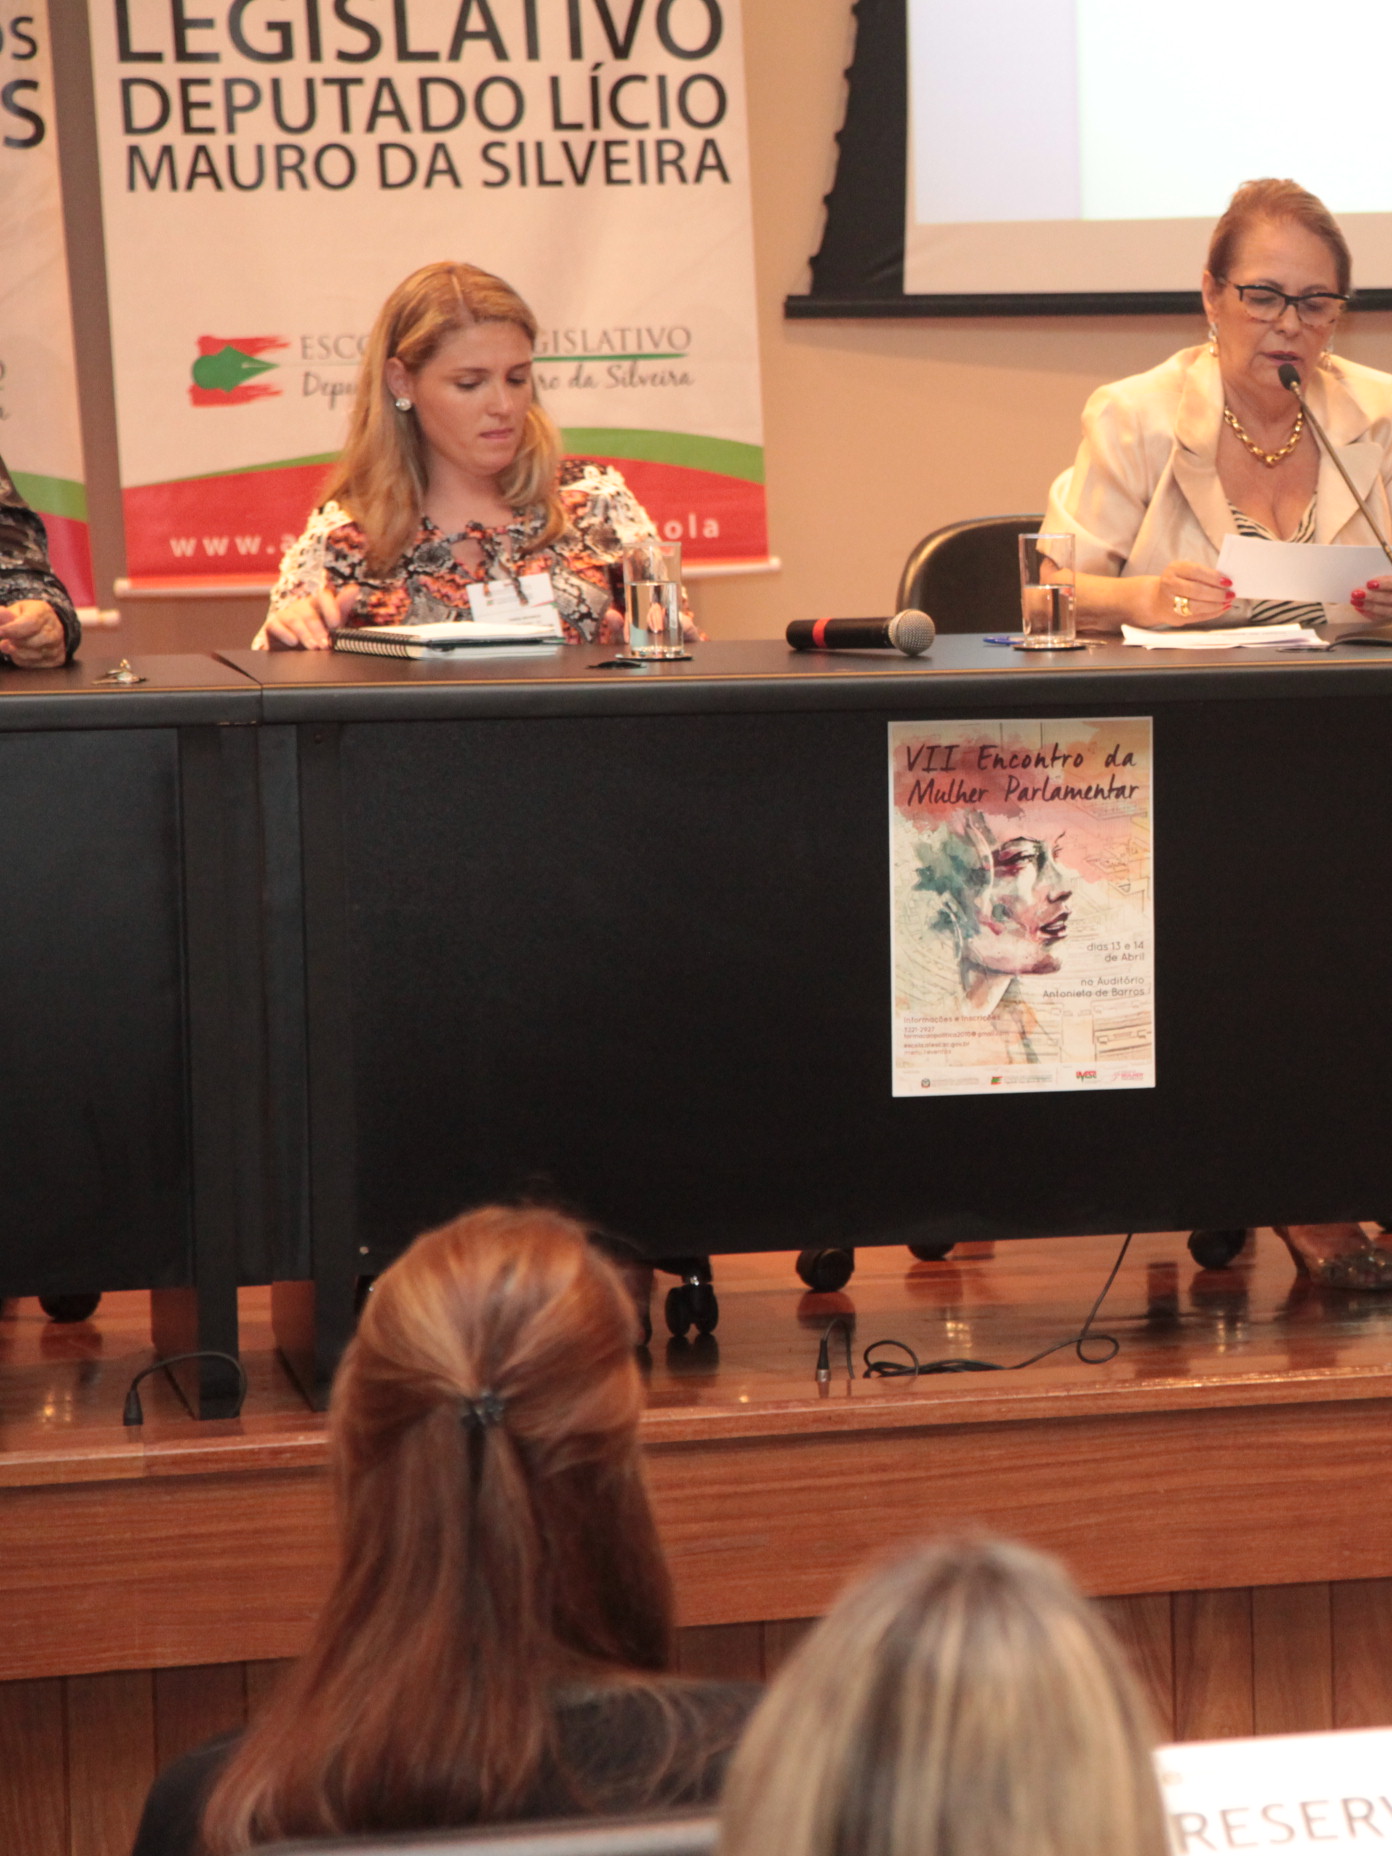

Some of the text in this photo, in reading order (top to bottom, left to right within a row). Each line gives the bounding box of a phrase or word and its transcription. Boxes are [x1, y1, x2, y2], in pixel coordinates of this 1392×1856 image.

[0, 16, 38, 60] S
[119, 62, 728, 136] DEPUTADO LÍCIO
[127, 138, 732, 192] MAURO DA SILVEIRA
[605, 359, 695, 390] Silveira
[906, 743, 1137, 774] VII Encontro da
[907, 773, 1140, 807] Mulher Parlamentar
[1086, 942, 1109, 952] dias
[1104, 952, 1145, 963] de Abril
[1042, 987, 1145, 999] Antonieta de Barros
